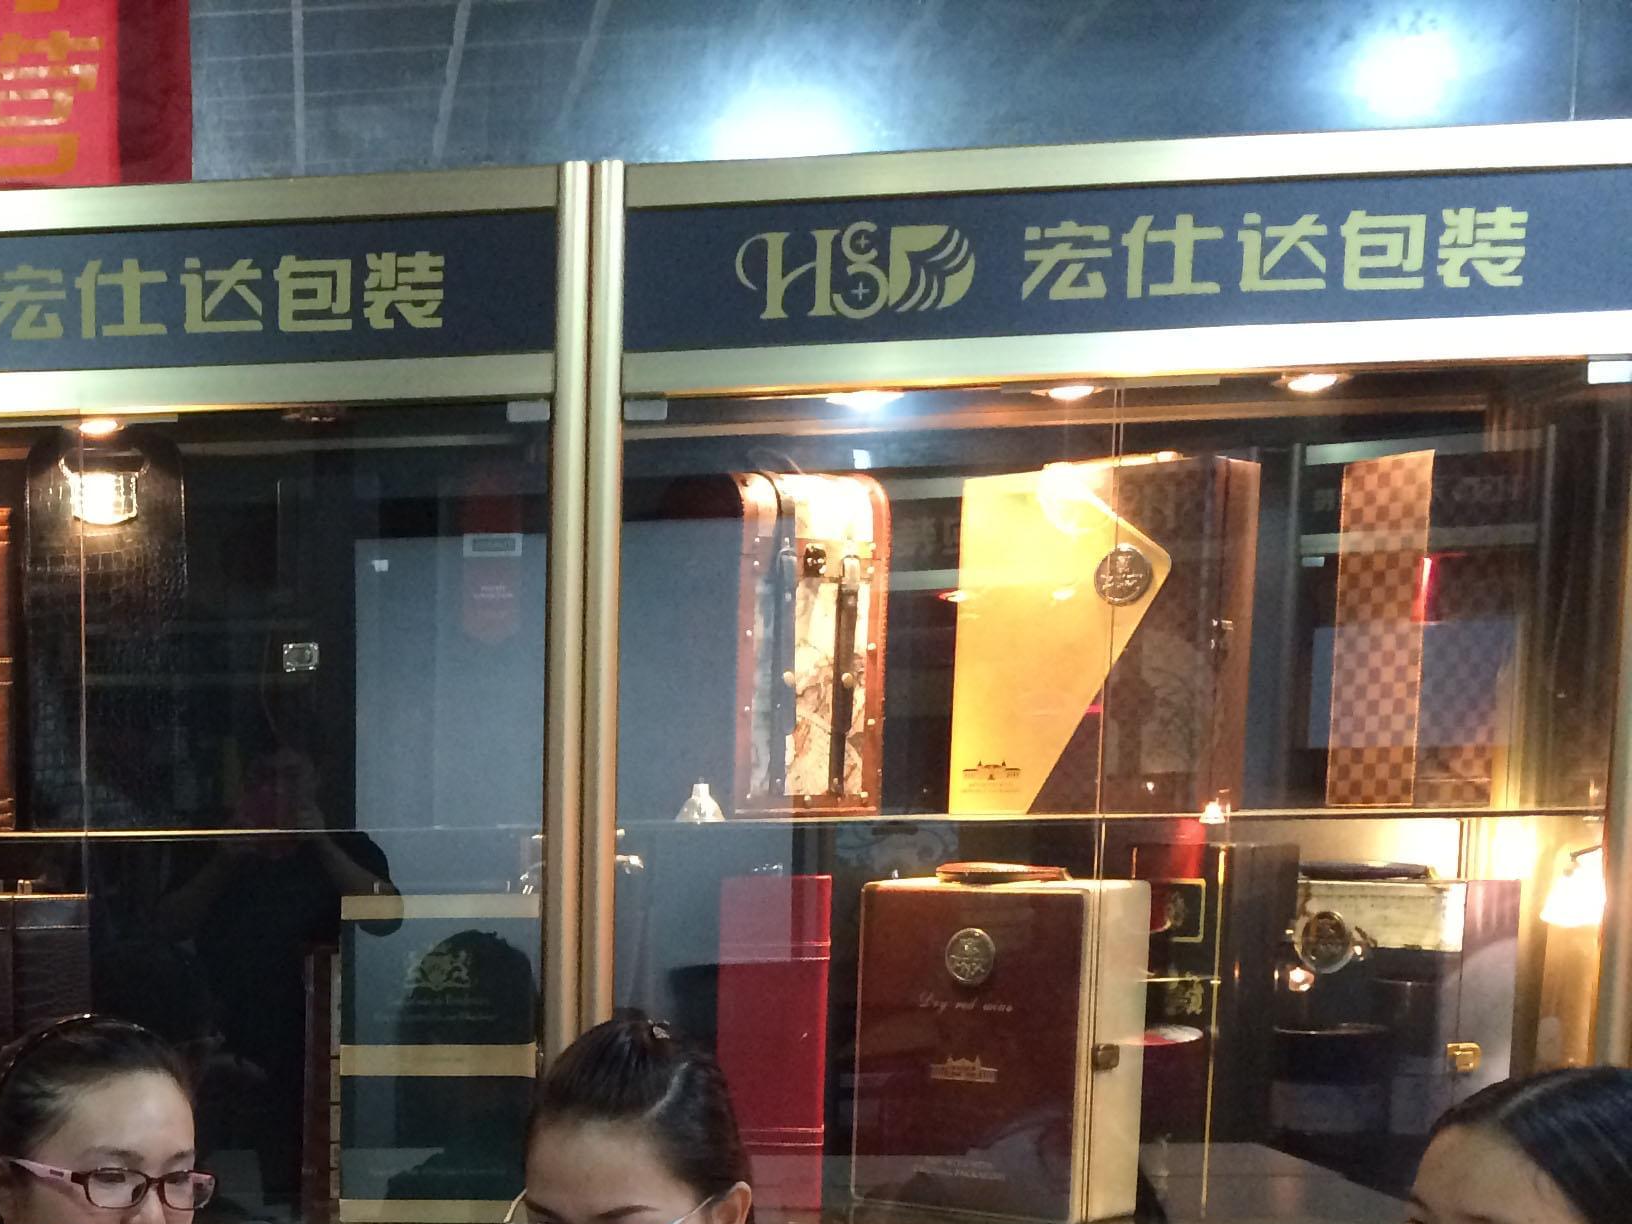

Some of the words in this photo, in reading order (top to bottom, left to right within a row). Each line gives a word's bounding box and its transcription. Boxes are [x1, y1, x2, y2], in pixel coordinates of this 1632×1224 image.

[1021, 205, 1529, 301] 宏仕达包装
